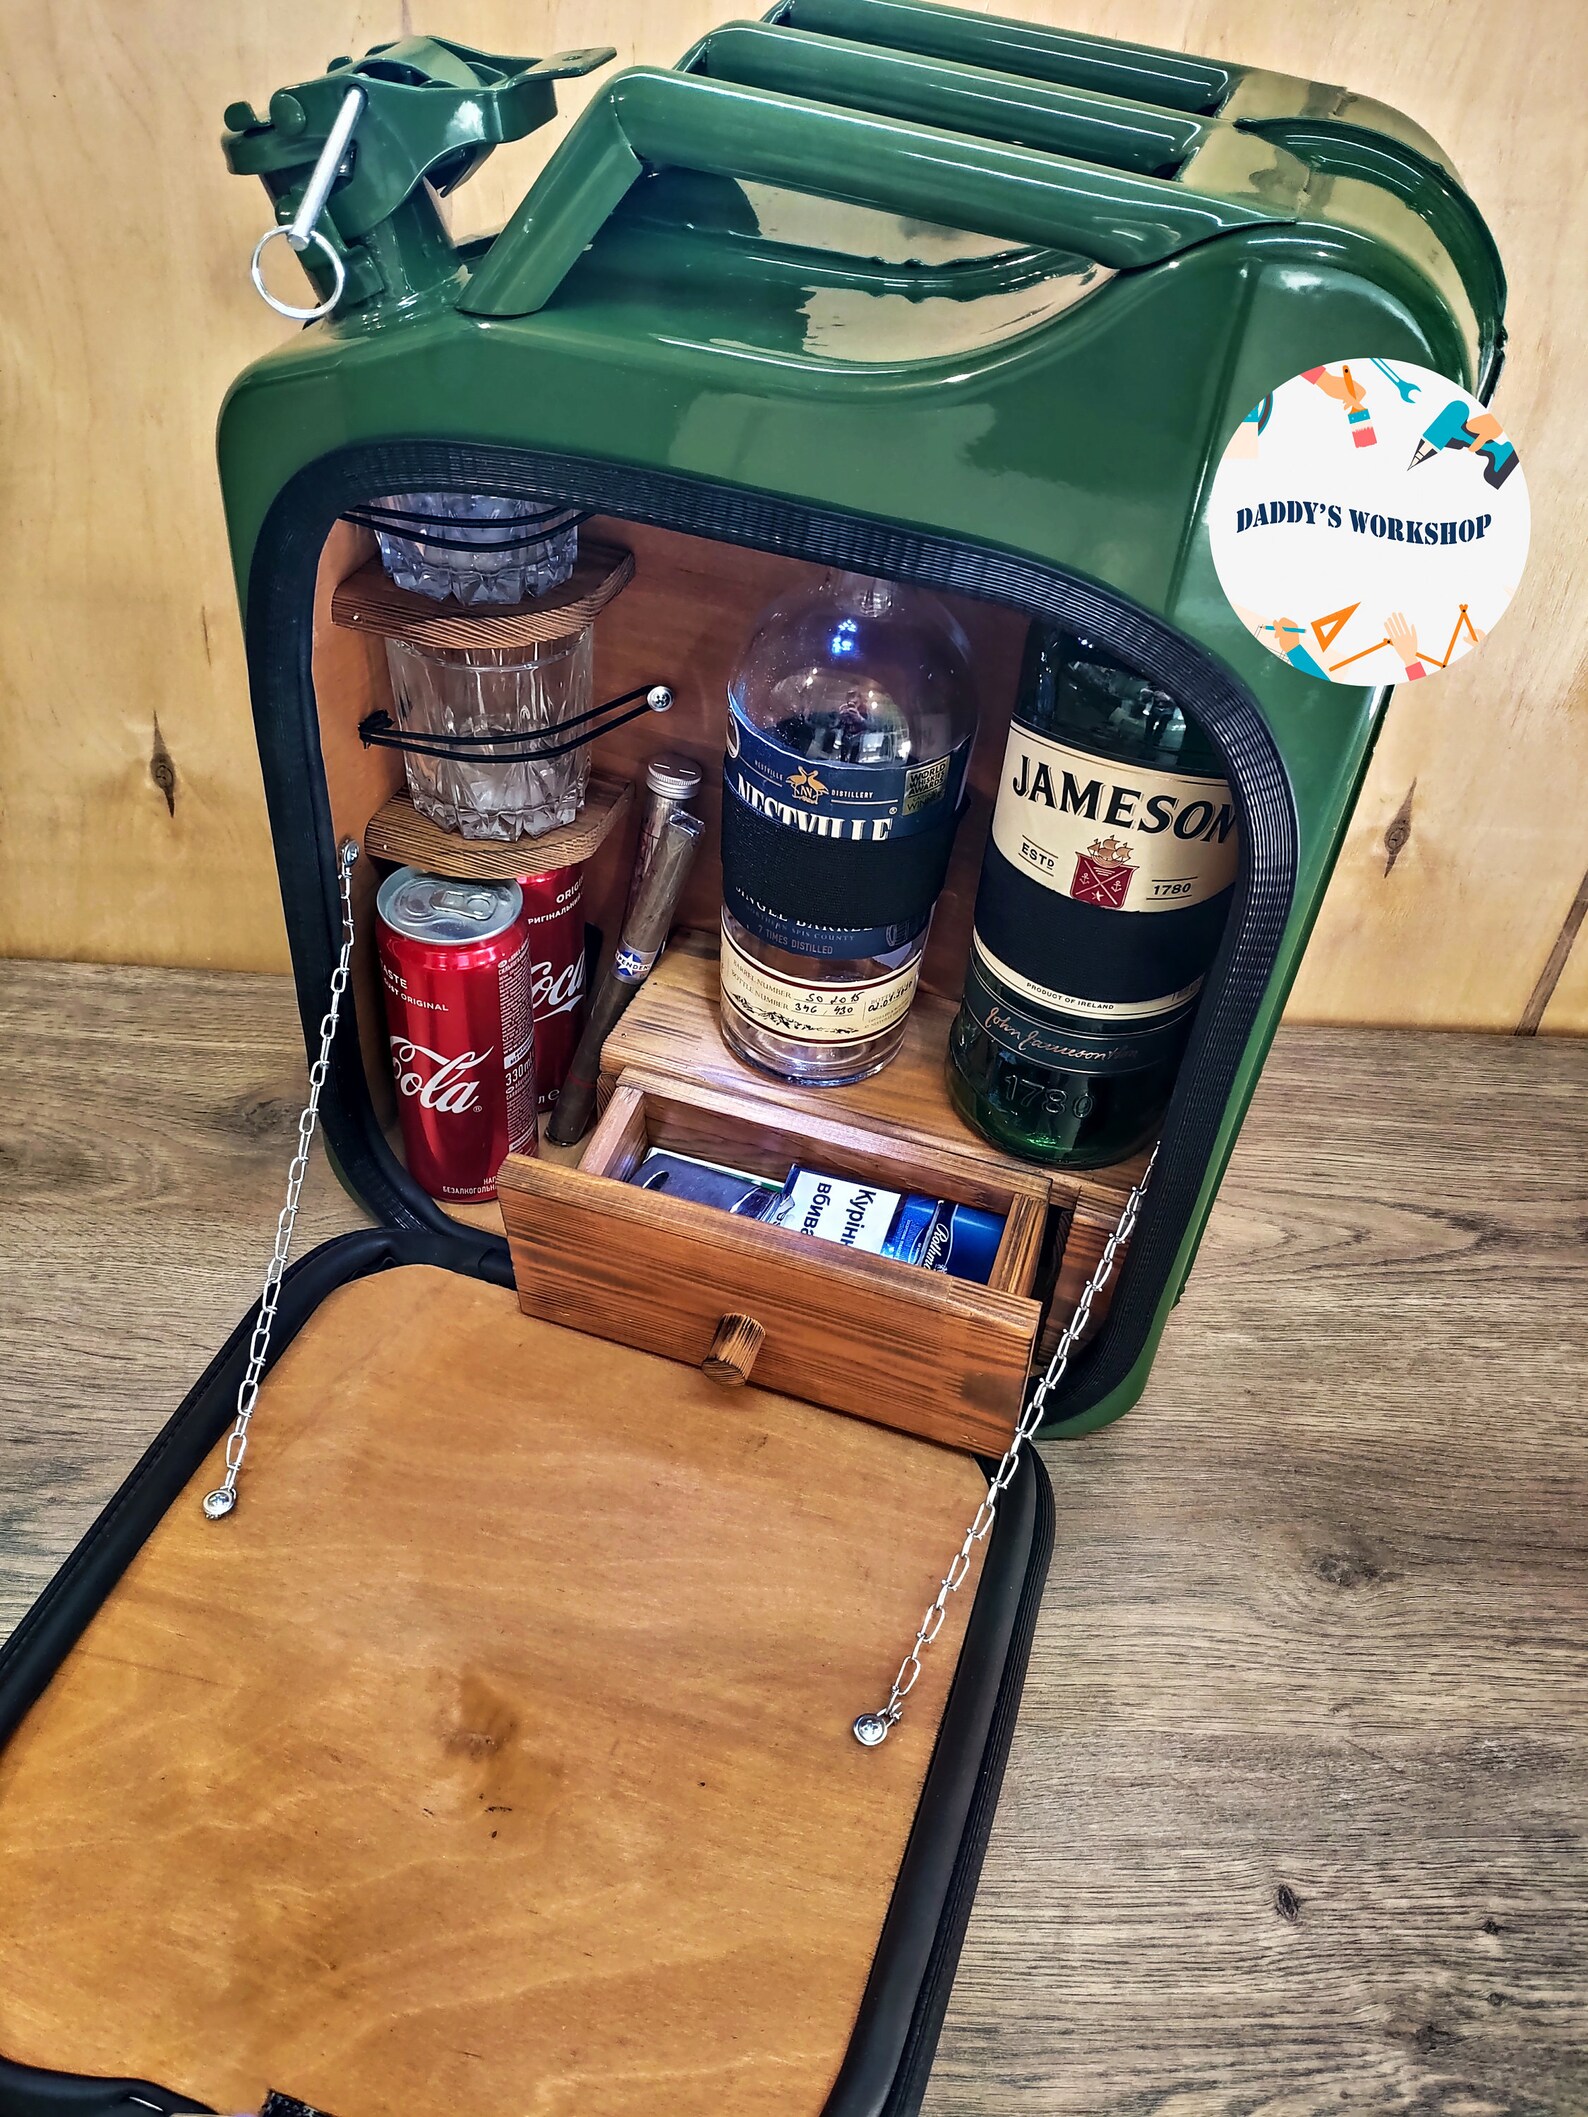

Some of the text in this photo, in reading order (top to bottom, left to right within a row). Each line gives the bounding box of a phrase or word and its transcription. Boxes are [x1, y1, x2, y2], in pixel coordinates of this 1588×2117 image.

[909, 770, 945, 789] WHISKIES
[910, 764, 946, 783] WORLD
[831, 789, 874, 799] DISTILLERY
[908, 778, 944, 796] AWARDS
[1012, 754, 1236, 844] JAMESON
[1153, 882, 1191, 896] 1780
[766, 929, 789, 946] TIMES
[791, 939, 833, 955] DISTILLED
[756, 979, 792, 999] NUMBER
[1026, 982, 1115, 1010] PRODUCT OF IRELAND
[400, 993, 449, 1011] ORIGINAL
[755, 990, 789, 1011] NUMBER
[984, 1006, 1021, 1039] John
[1018, 1030, 1106, 1061] Jameson
[1004, 1075, 1094, 1118] 1780
